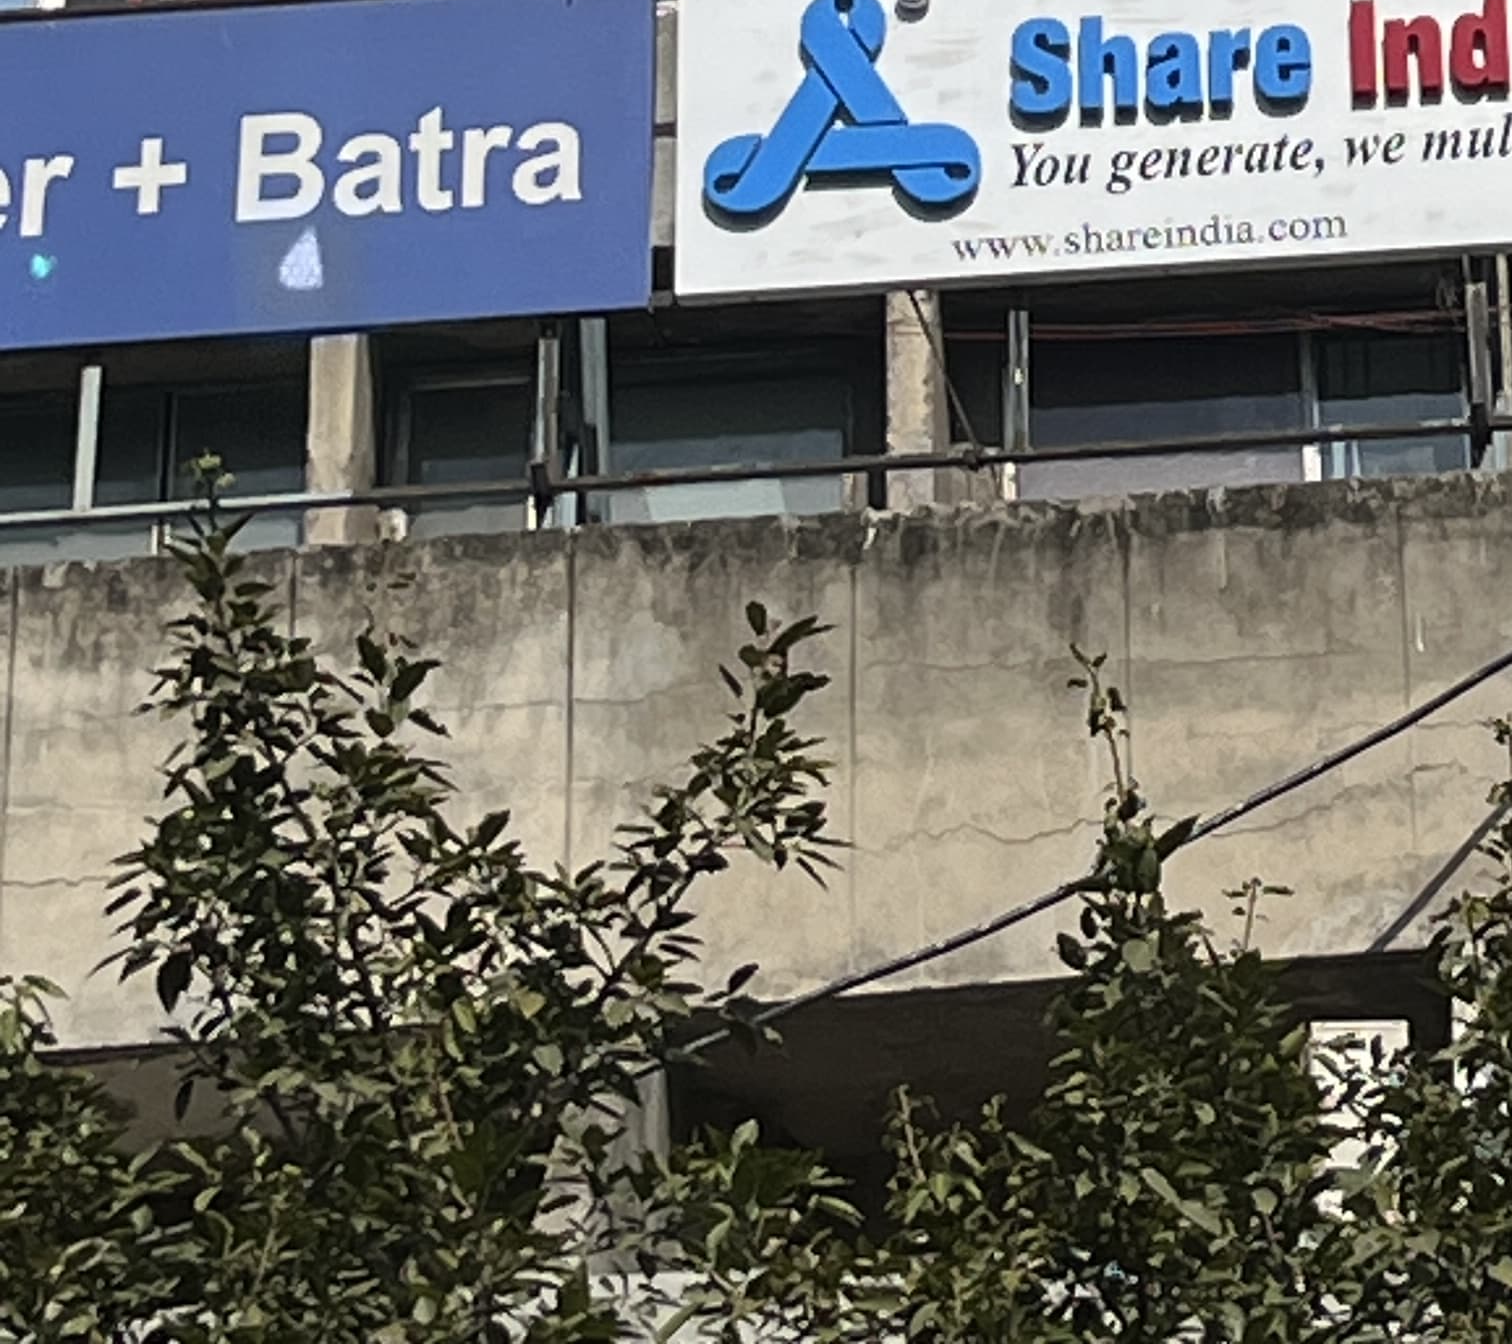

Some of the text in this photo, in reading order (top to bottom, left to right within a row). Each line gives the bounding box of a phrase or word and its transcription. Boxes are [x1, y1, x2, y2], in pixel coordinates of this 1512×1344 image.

[1010, 14, 1314, 127] Share
[0, 154, 75, 238] r
[235, 105, 583, 223] Batra
[1010, 144, 1090, 188] You
[1106, 134, 1326, 195] generate,
[1344, 132, 1406, 167] we
[951, 214, 1349, 262] www.shareindia.com
